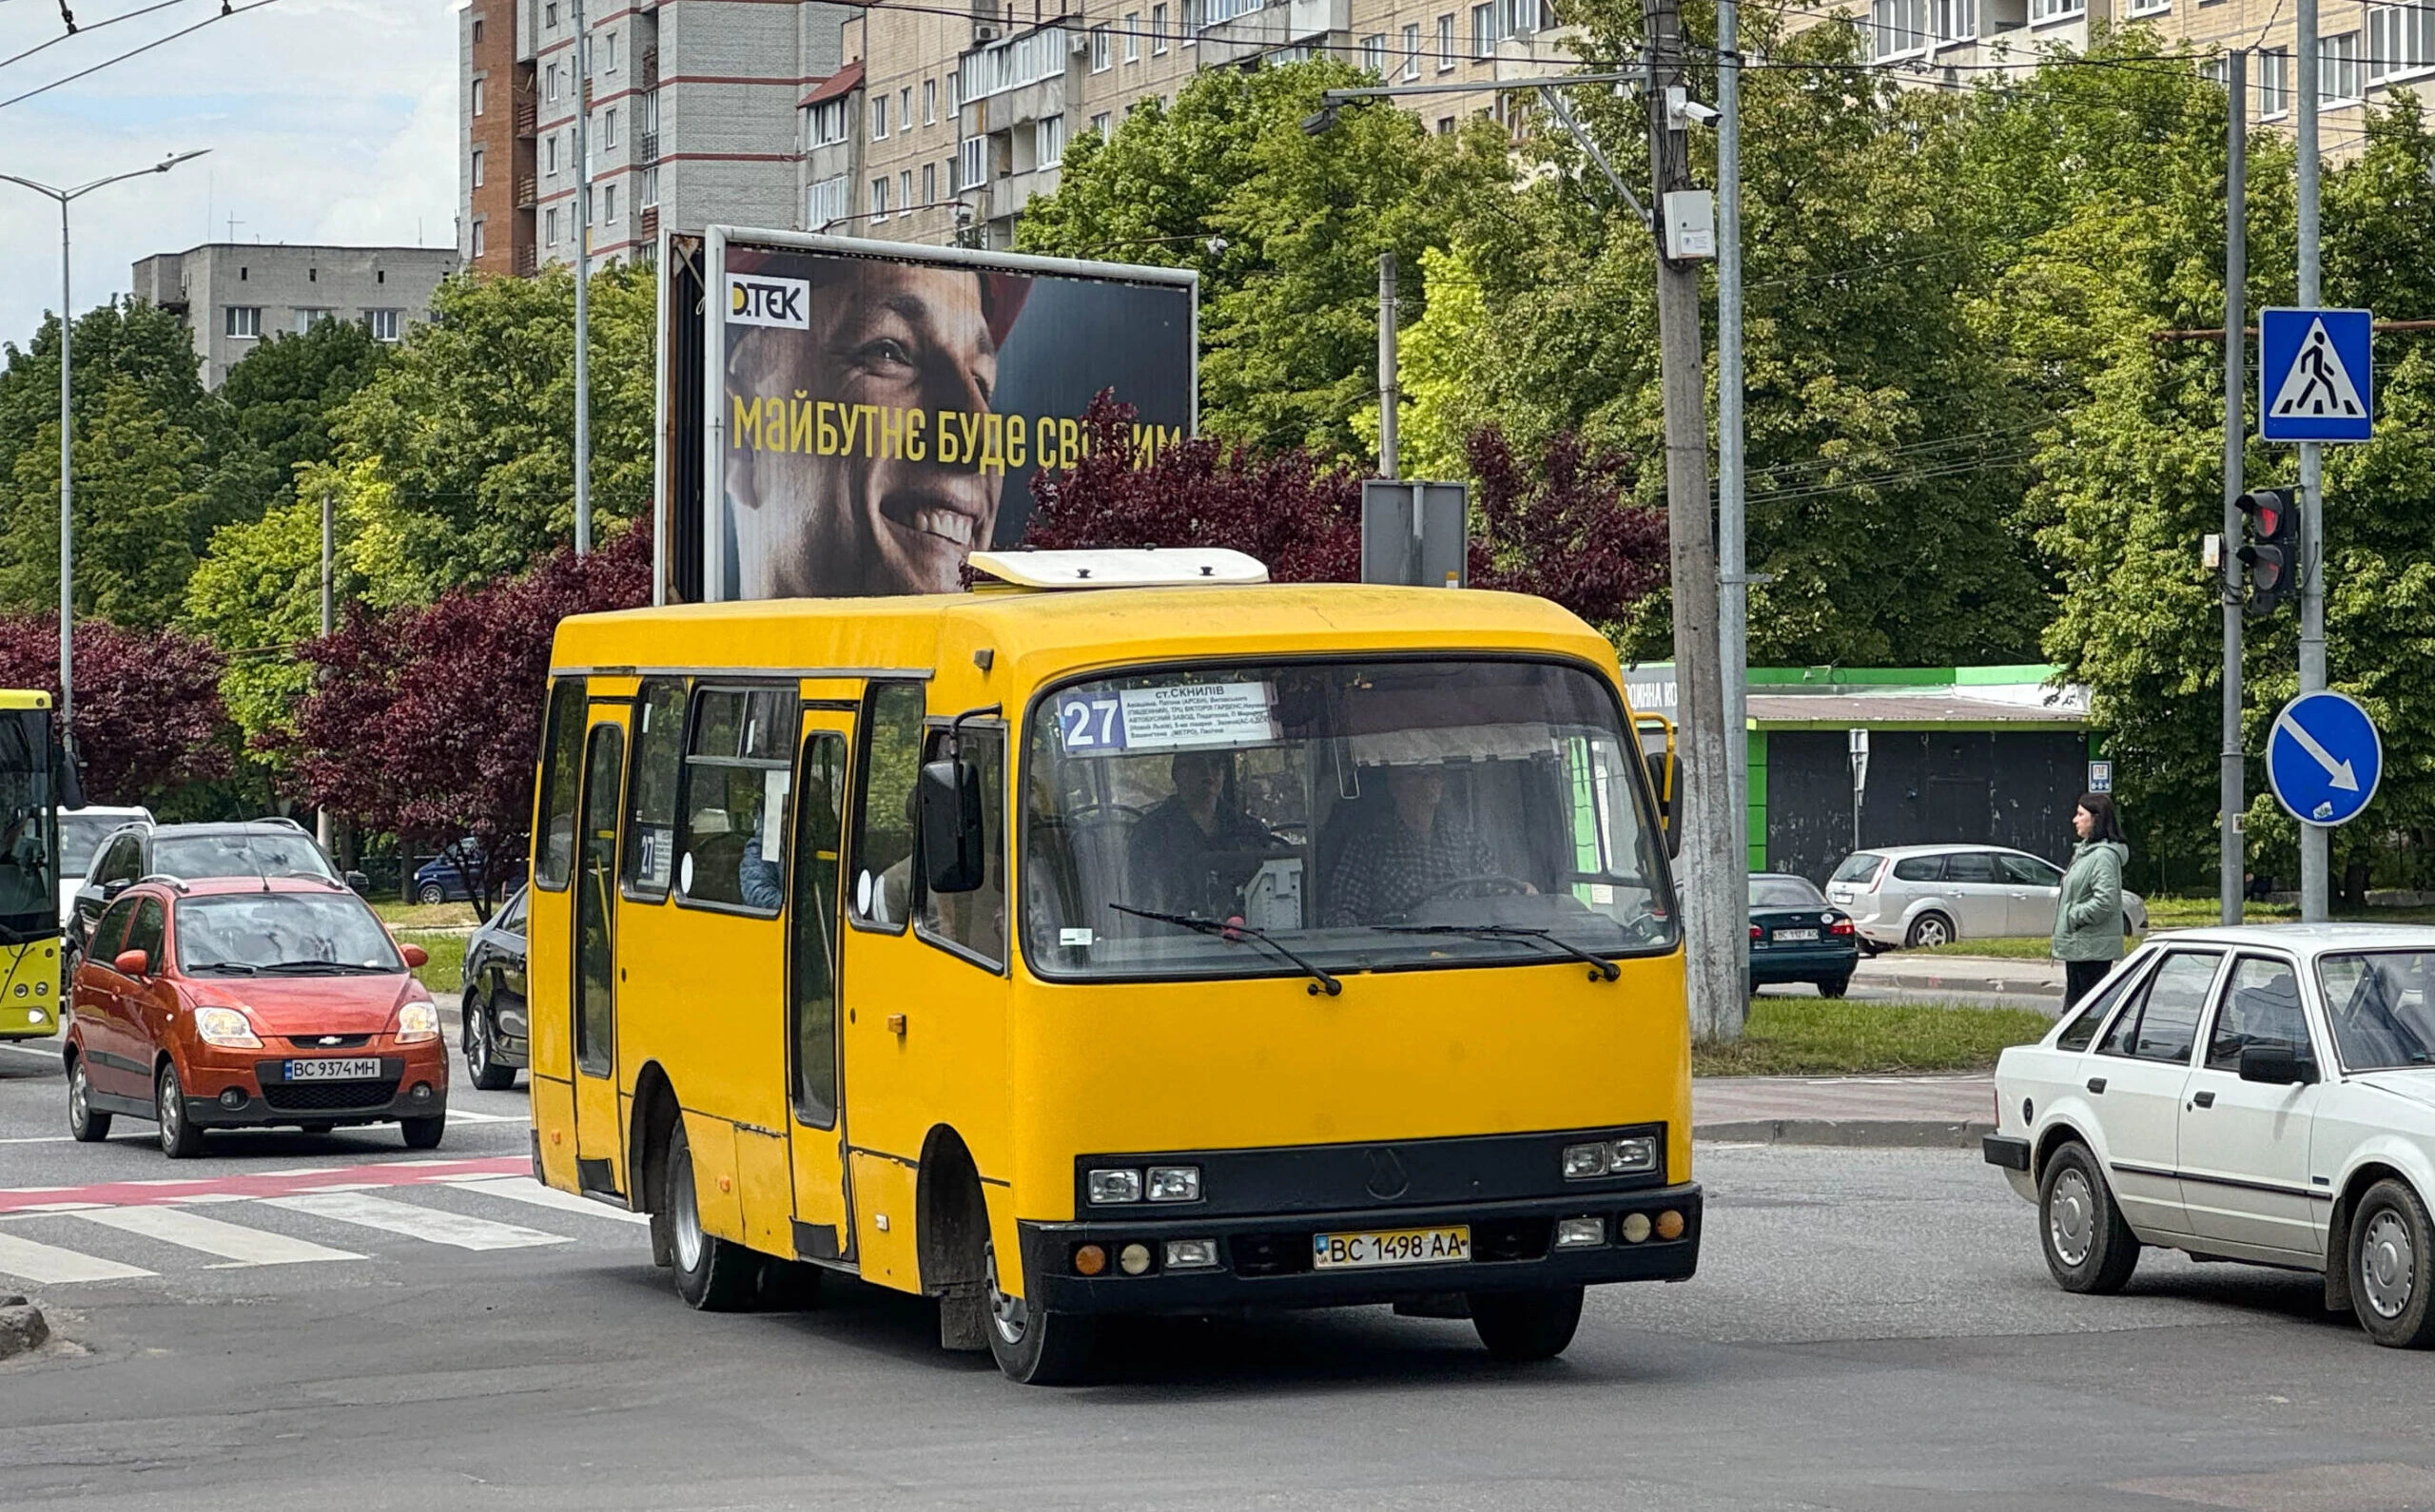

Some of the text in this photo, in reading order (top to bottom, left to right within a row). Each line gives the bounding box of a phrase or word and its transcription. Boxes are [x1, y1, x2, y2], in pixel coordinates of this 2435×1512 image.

[1155, 685, 1225, 699] ст.СКНИЛІВ
[1063, 699, 1119, 746] 27
[641, 835, 654, 874] 27
[294, 1061, 375, 1076] BC 9374 MH
[1332, 1232, 1462, 1262] BC 1498 AA
